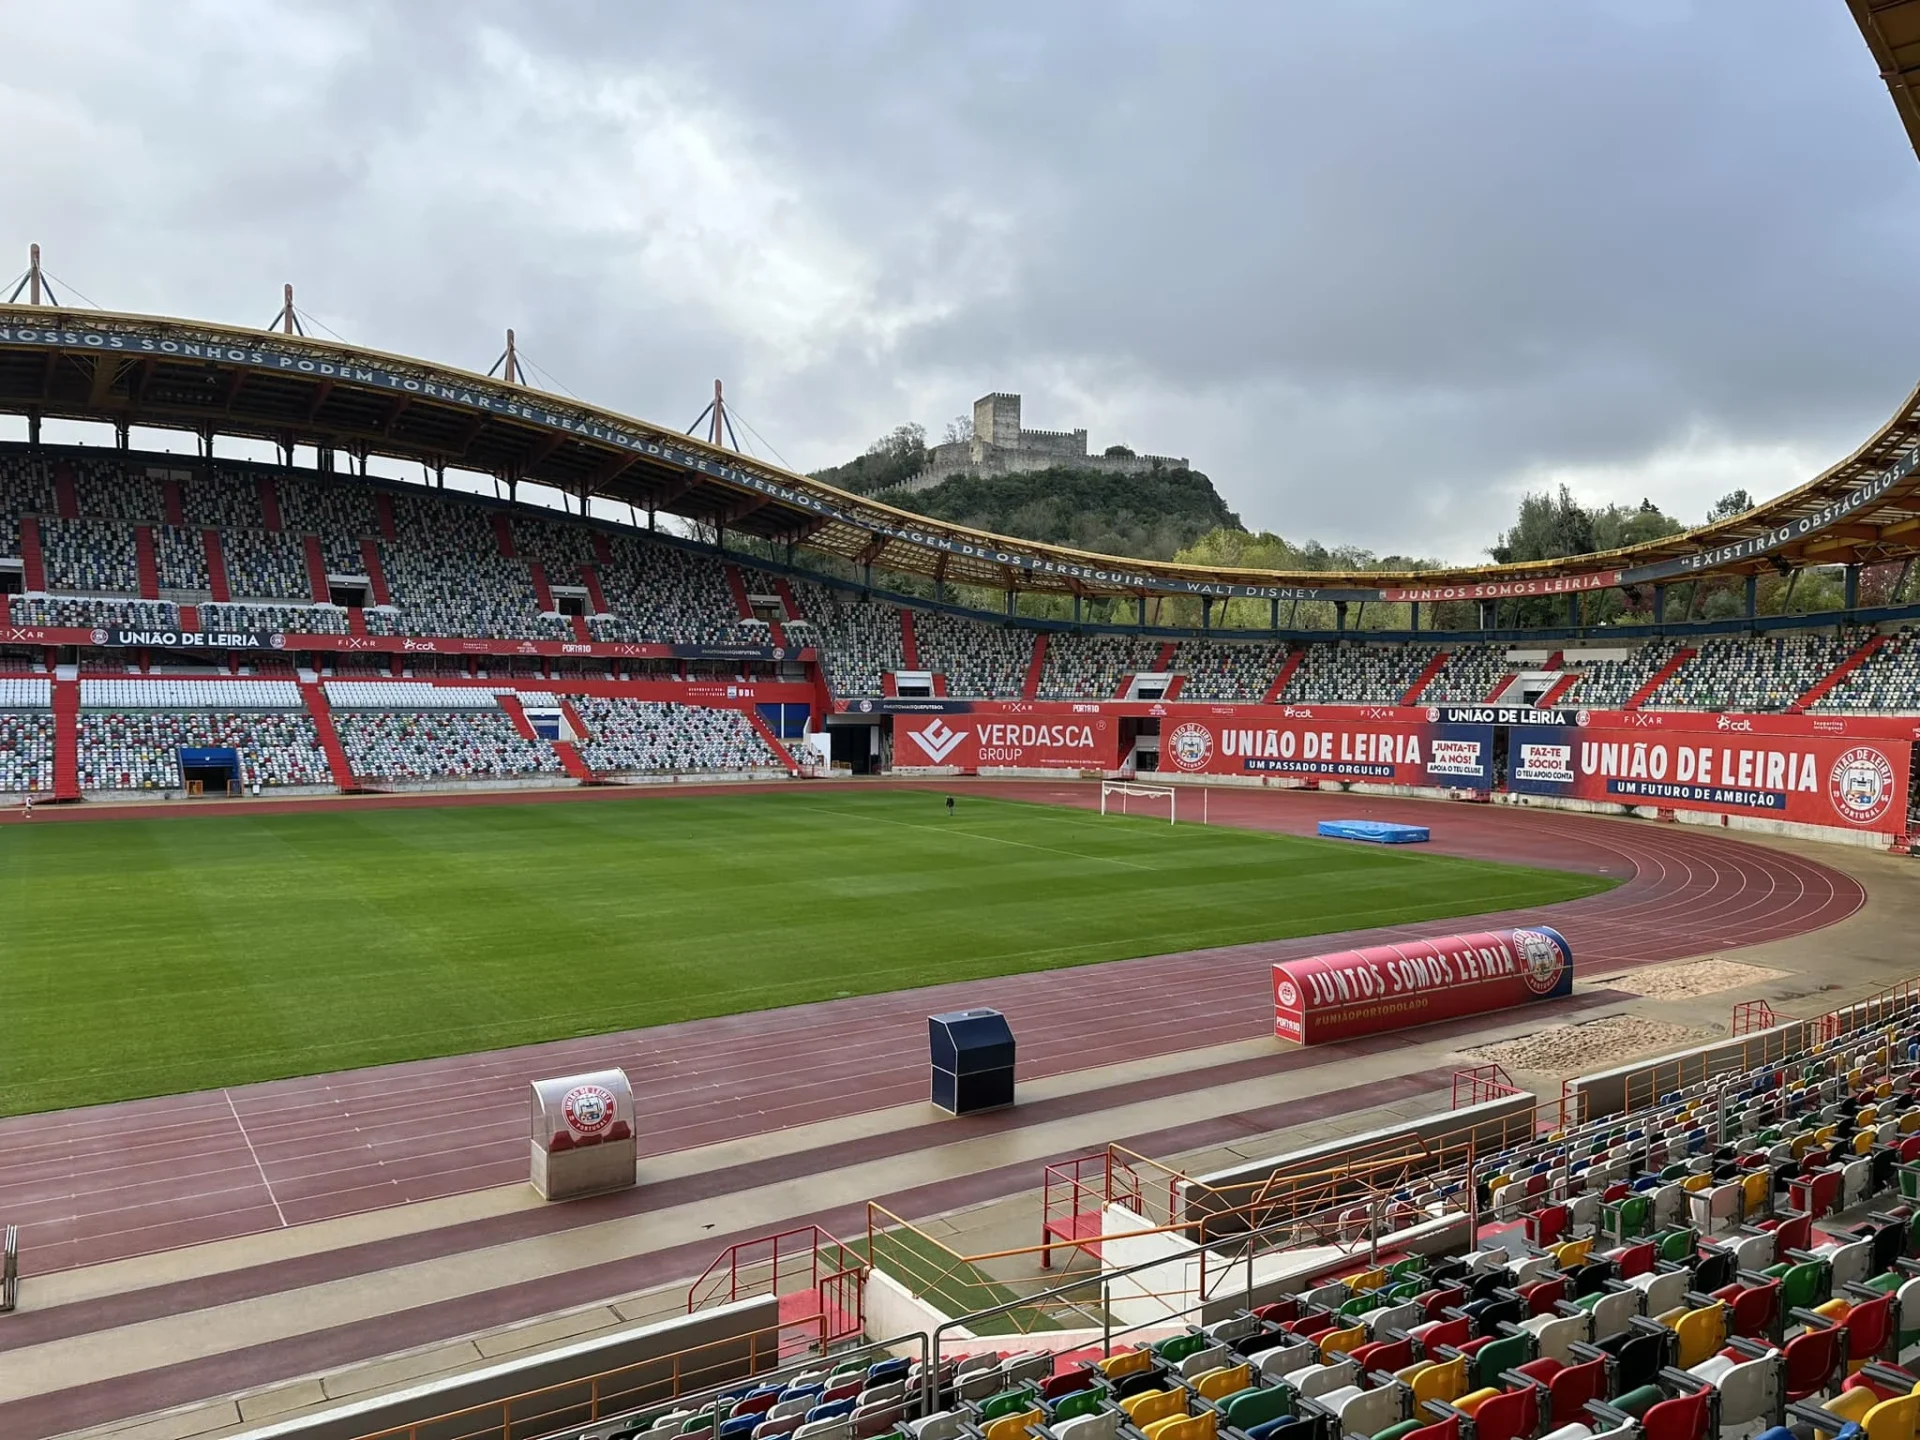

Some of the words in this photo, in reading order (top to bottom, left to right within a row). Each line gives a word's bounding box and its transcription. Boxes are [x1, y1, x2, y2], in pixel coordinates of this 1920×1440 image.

[0, 328, 123, 348] NOSSOS
[141, 339, 263, 364] SONHOS
[279, 357, 374, 382] PODEM
[388, 376, 532, 419] TORNAR-SE
[545, 414, 674, 460] REALIDADE
[684, 454, 707, 471] SE
[719, 466, 823, 511] TIVERMOS
[962, 545, 985, 557] DE
[996, 553, 1021, 565] OS
[1186, 582, 1236, 595] WALT
[1246, 586, 1319, 599] DISNEY
[1798, 467, 1906, 533] OBSTÁCULOS.
[1398, 587, 1467, 600] JUNTOS
[1475, 582, 1536, 597] SOMOS
[1544, 575, 1601, 592] LEIRIA
[119, 631, 177, 645] UNIÃO
[182, 632, 204, 646] DE
[208, 633, 259, 647] LEIRIA
[338, 637, 376, 649] FIXAR
[615, 644, 647, 655] FIXAR
[1002, 702, 1033, 713] FIXAR
[1360, 707, 1394, 719] FIXAR
[1448, 709, 1494, 723] UNIÃO
[1499, 710, 1519, 723] DE
[1521, 712, 1566, 725] LEIRIA
[1624, 713, 1663, 727] FIXAR
[976, 724, 1094, 748] VERDASCA
[1221, 728, 1296, 758] UNIÃO
[1303, 731, 1333, 760] DE
[1341, 733, 1421, 764] LEIRIA
[1434, 742, 1478, 754] JUNTA-TE
[1530, 747, 1561, 758] FAZ-TE
[978, 749, 1022, 761] GROUP
[1439, 754, 1448, 763] A
[1449, 752, 1472, 765] NÓS!
[1249, 760, 1266, 770] UM
[1269, 761, 1316, 772] PASSADO
[1320, 763, 1335, 773] DE
[1338, 765, 1390, 776] ORGULHO
[1429, 764, 1447, 772] APOIA
[1453, 765, 1464, 774] TEU
[1464, 766, 1481, 775] CLUBE
[1528, 757, 1562, 770] SÓCIO!
[1581, 742, 1668, 780] UNIÃO
[1677, 746, 1713, 784] DE
[1721, 749, 1818, 793] LEIRIA
[1832, 753, 1854, 782] UNIÃO
[1856, 749, 1869, 760] DE
[1870, 753, 1891, 785] LEIRIA
[1534, 771, 1552, 779] APOIO
[1553, 772, 1573, 780] CONTA
[1617, 782, 1636, 793] UM
[1641, 783, 1689, 798] FUTURO
[1694, 788, 1711, 800] DE
[1715, 791, 1775, 808] AMBIÇÃO
[1840, 803, 1880, 819] PORTUGAL
[1306, 964, 1385, 1006] JUNTOS
[1387, 954, 1453, 992] SOMOS
[1453, 945, 1516, 981] LEIRIA
